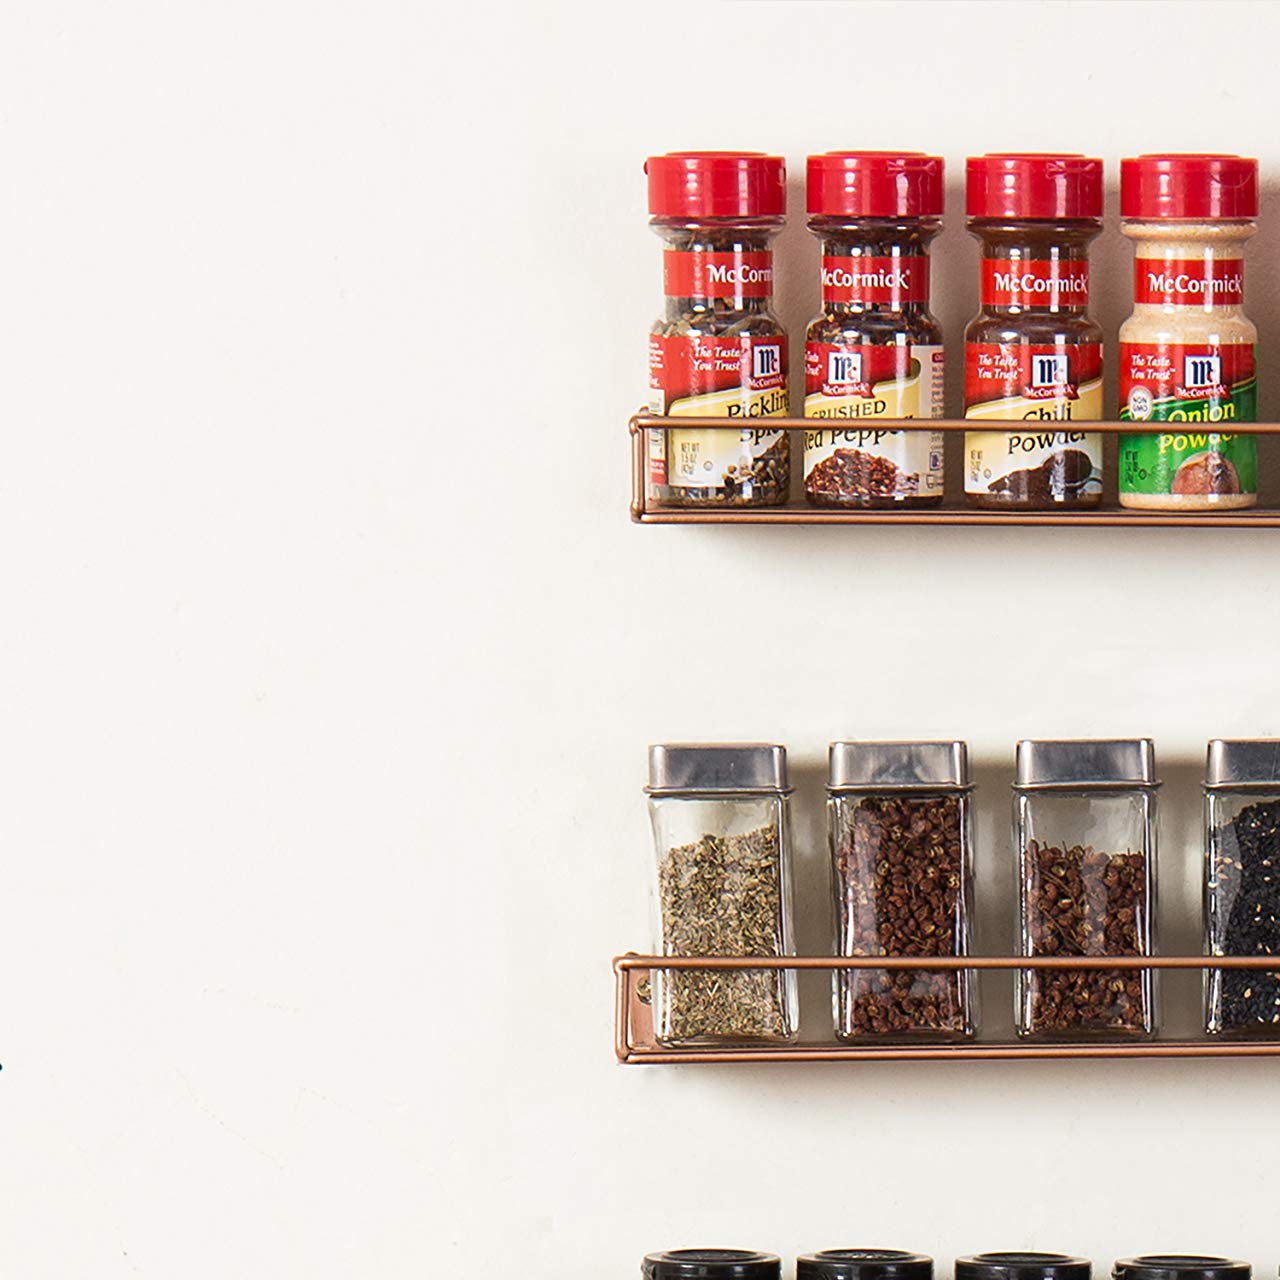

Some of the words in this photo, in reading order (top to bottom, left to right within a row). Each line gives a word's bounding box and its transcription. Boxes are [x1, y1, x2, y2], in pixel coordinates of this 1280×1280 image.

[993, 272, 1088, 294] McCormick
[1147, 272, 1242, 294] McCormick
[714, 346, 740, 358] Taste
[692, 359, 711, 371] You
[714, 360, 740, 371] Trust
[1131, 354, 1145, 367] The
[1147, 355, 1171, 367] Taste
[1130, 368, 1145, 380] You
[1147, 368, 1171, 380] Trust
